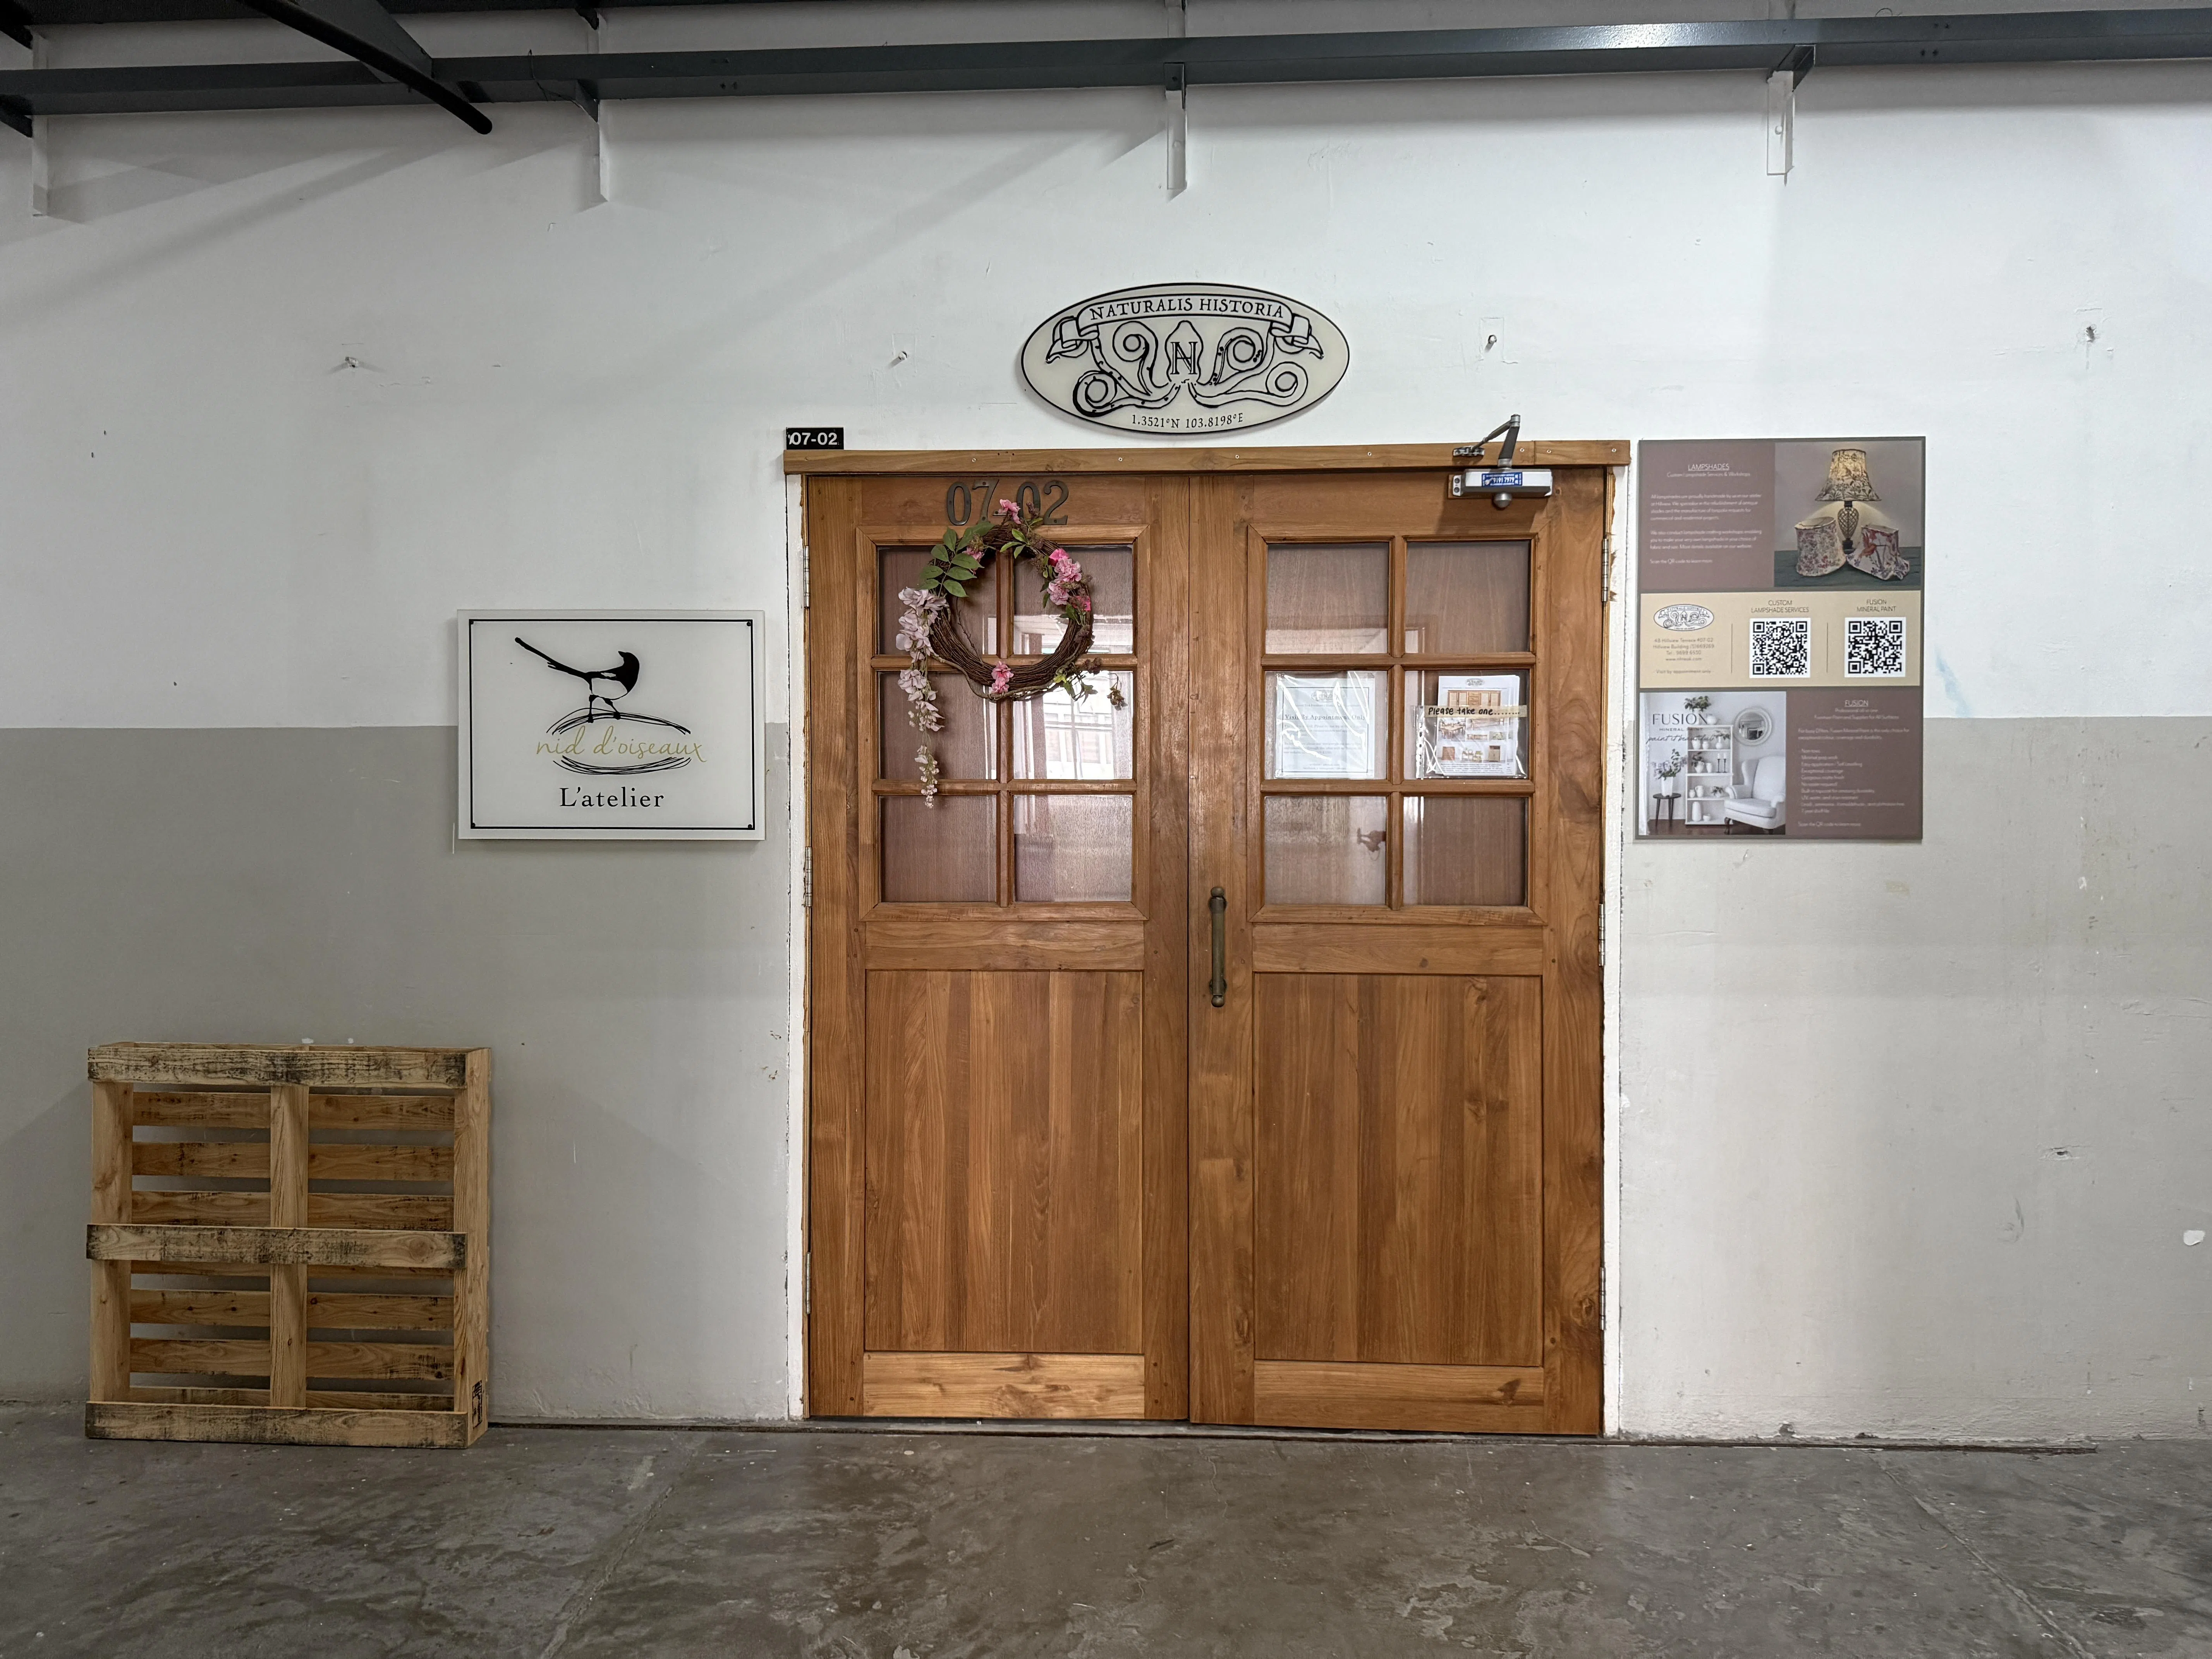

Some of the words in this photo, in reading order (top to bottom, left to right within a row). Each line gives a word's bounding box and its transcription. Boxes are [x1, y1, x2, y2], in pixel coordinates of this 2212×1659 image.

[1089, 297, 1193, 321] NATURALIS
[1199, 298, 1283, 318] HISTORIA
[1652, 713, 1708, 725] FUSION
[536, 725, 586, 755] nid
[593, 725, 708, 763] d'oiseaux
[559, 787, 665, 807] L'atelier
